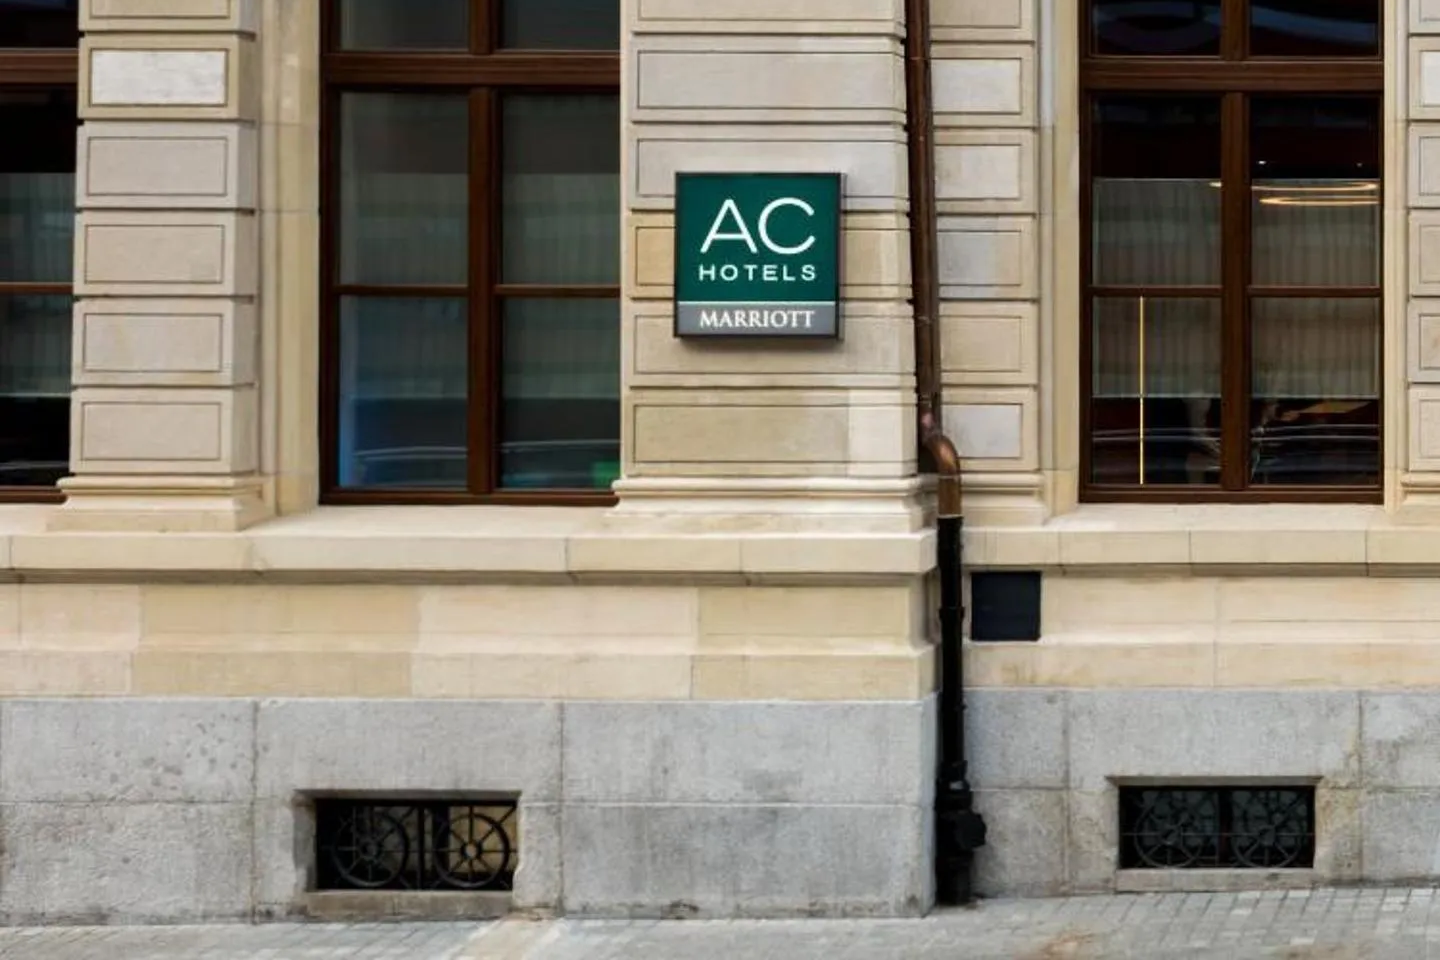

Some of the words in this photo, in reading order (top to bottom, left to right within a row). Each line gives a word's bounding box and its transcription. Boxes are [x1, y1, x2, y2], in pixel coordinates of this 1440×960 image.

[700, 197, 816, 255] AC
[699, 264, 817, 281] HOTELS
[699, 310, 816, 328] MARRIOTT
